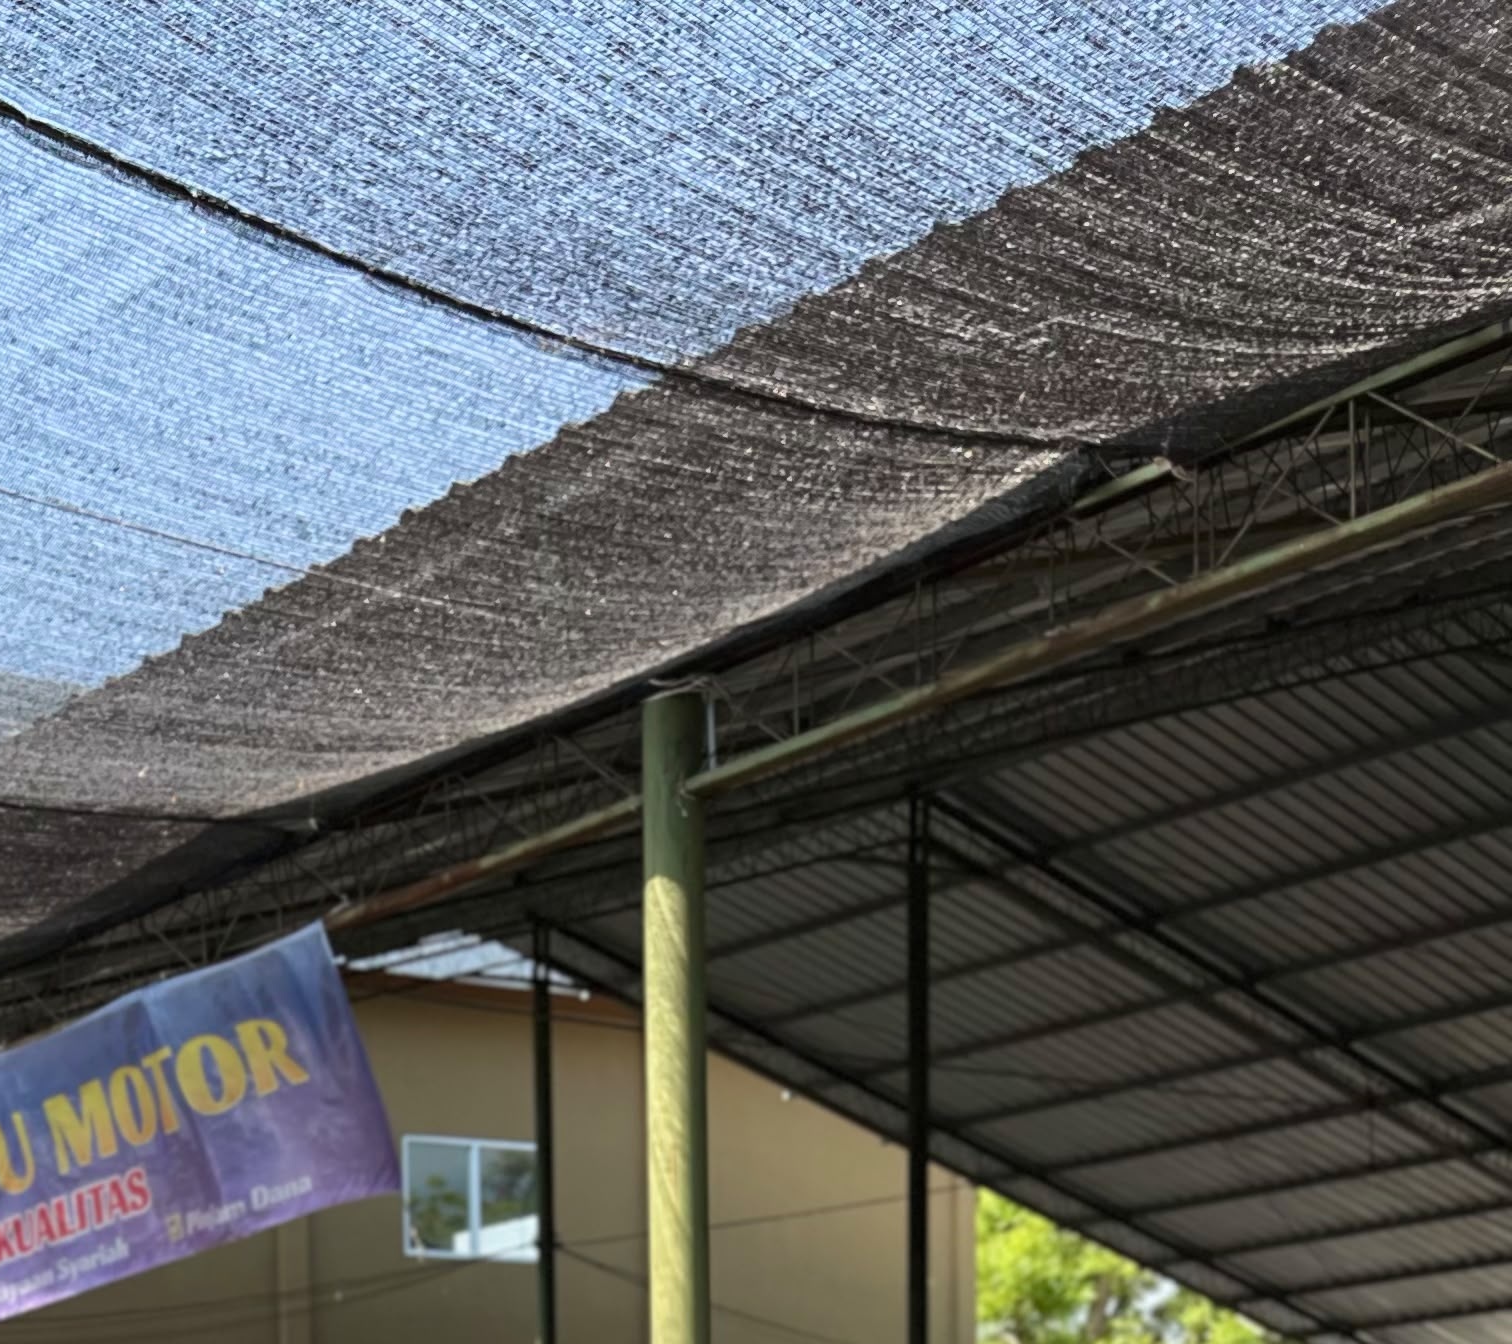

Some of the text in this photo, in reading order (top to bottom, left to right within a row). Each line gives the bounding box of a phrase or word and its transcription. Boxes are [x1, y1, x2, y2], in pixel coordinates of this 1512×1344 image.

[43, 1019, 310, 1176] MOTOR
[250, 1175, 313, 1211] Dana
[56, 1239, 130, 1282] Syariah
